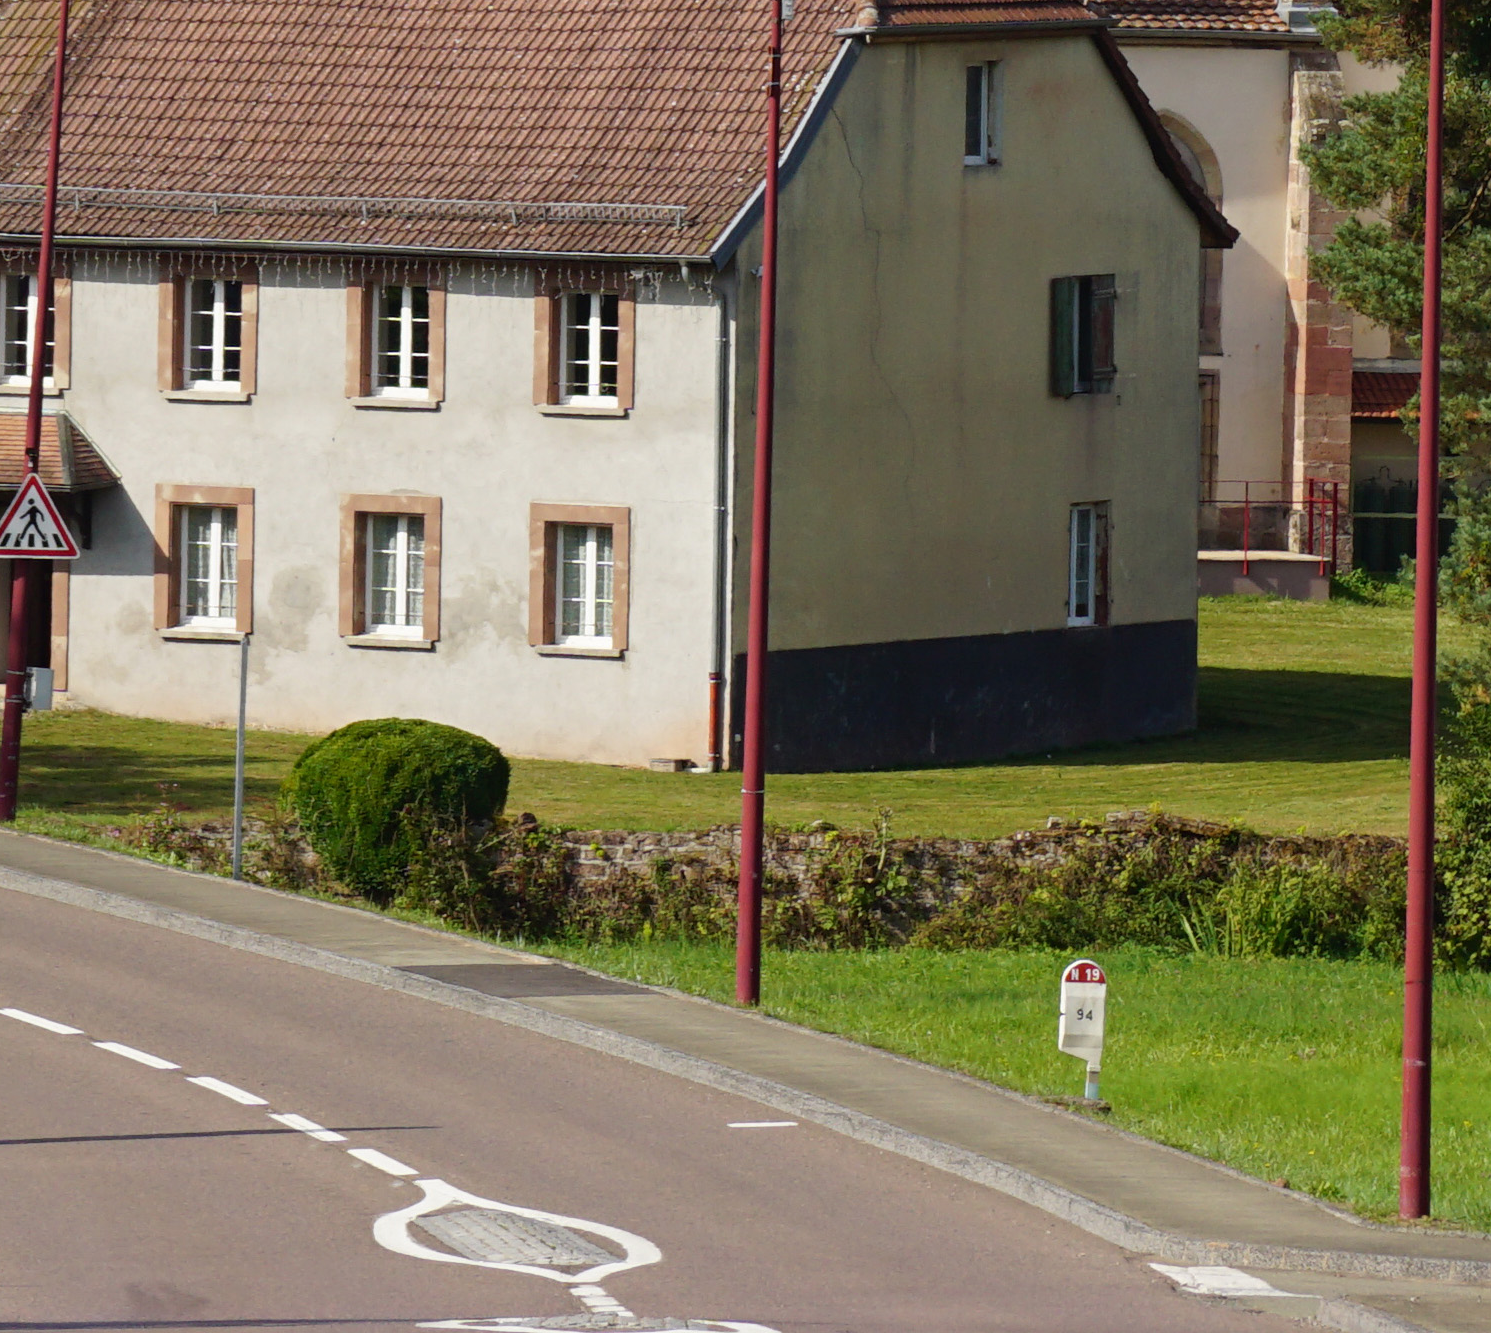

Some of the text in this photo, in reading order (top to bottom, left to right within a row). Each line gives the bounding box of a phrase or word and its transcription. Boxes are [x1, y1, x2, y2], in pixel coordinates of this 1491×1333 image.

[1070, 968, 1100, 981] N 19
[1076, 1008, 1093, 1021] 94
